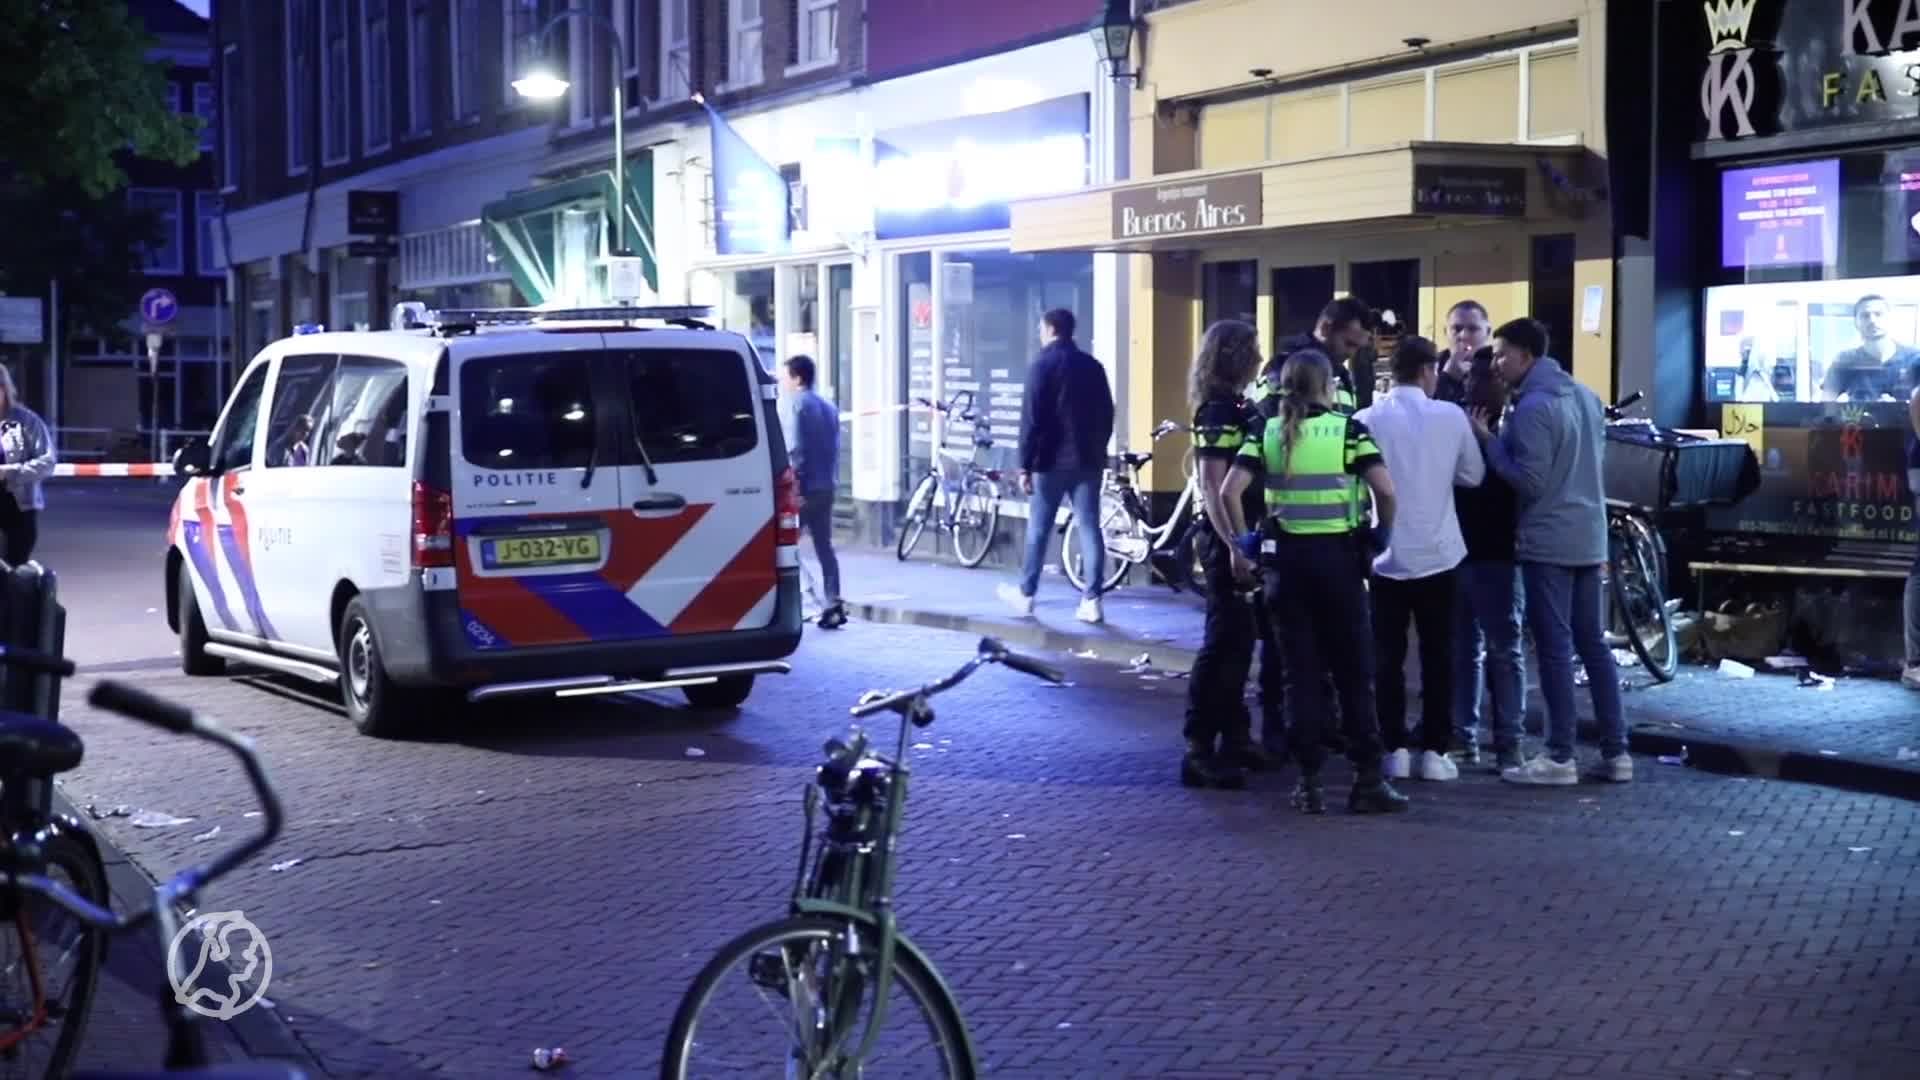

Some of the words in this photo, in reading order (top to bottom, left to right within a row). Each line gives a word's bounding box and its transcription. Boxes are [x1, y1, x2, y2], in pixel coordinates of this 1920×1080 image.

[1122, 206, 1187, 236] Buenos
[1194, 198, 1246, 229] Aires
[473, 472, 557, 487] POLITIE
[500, 537, 591, 561] J-032-VG
